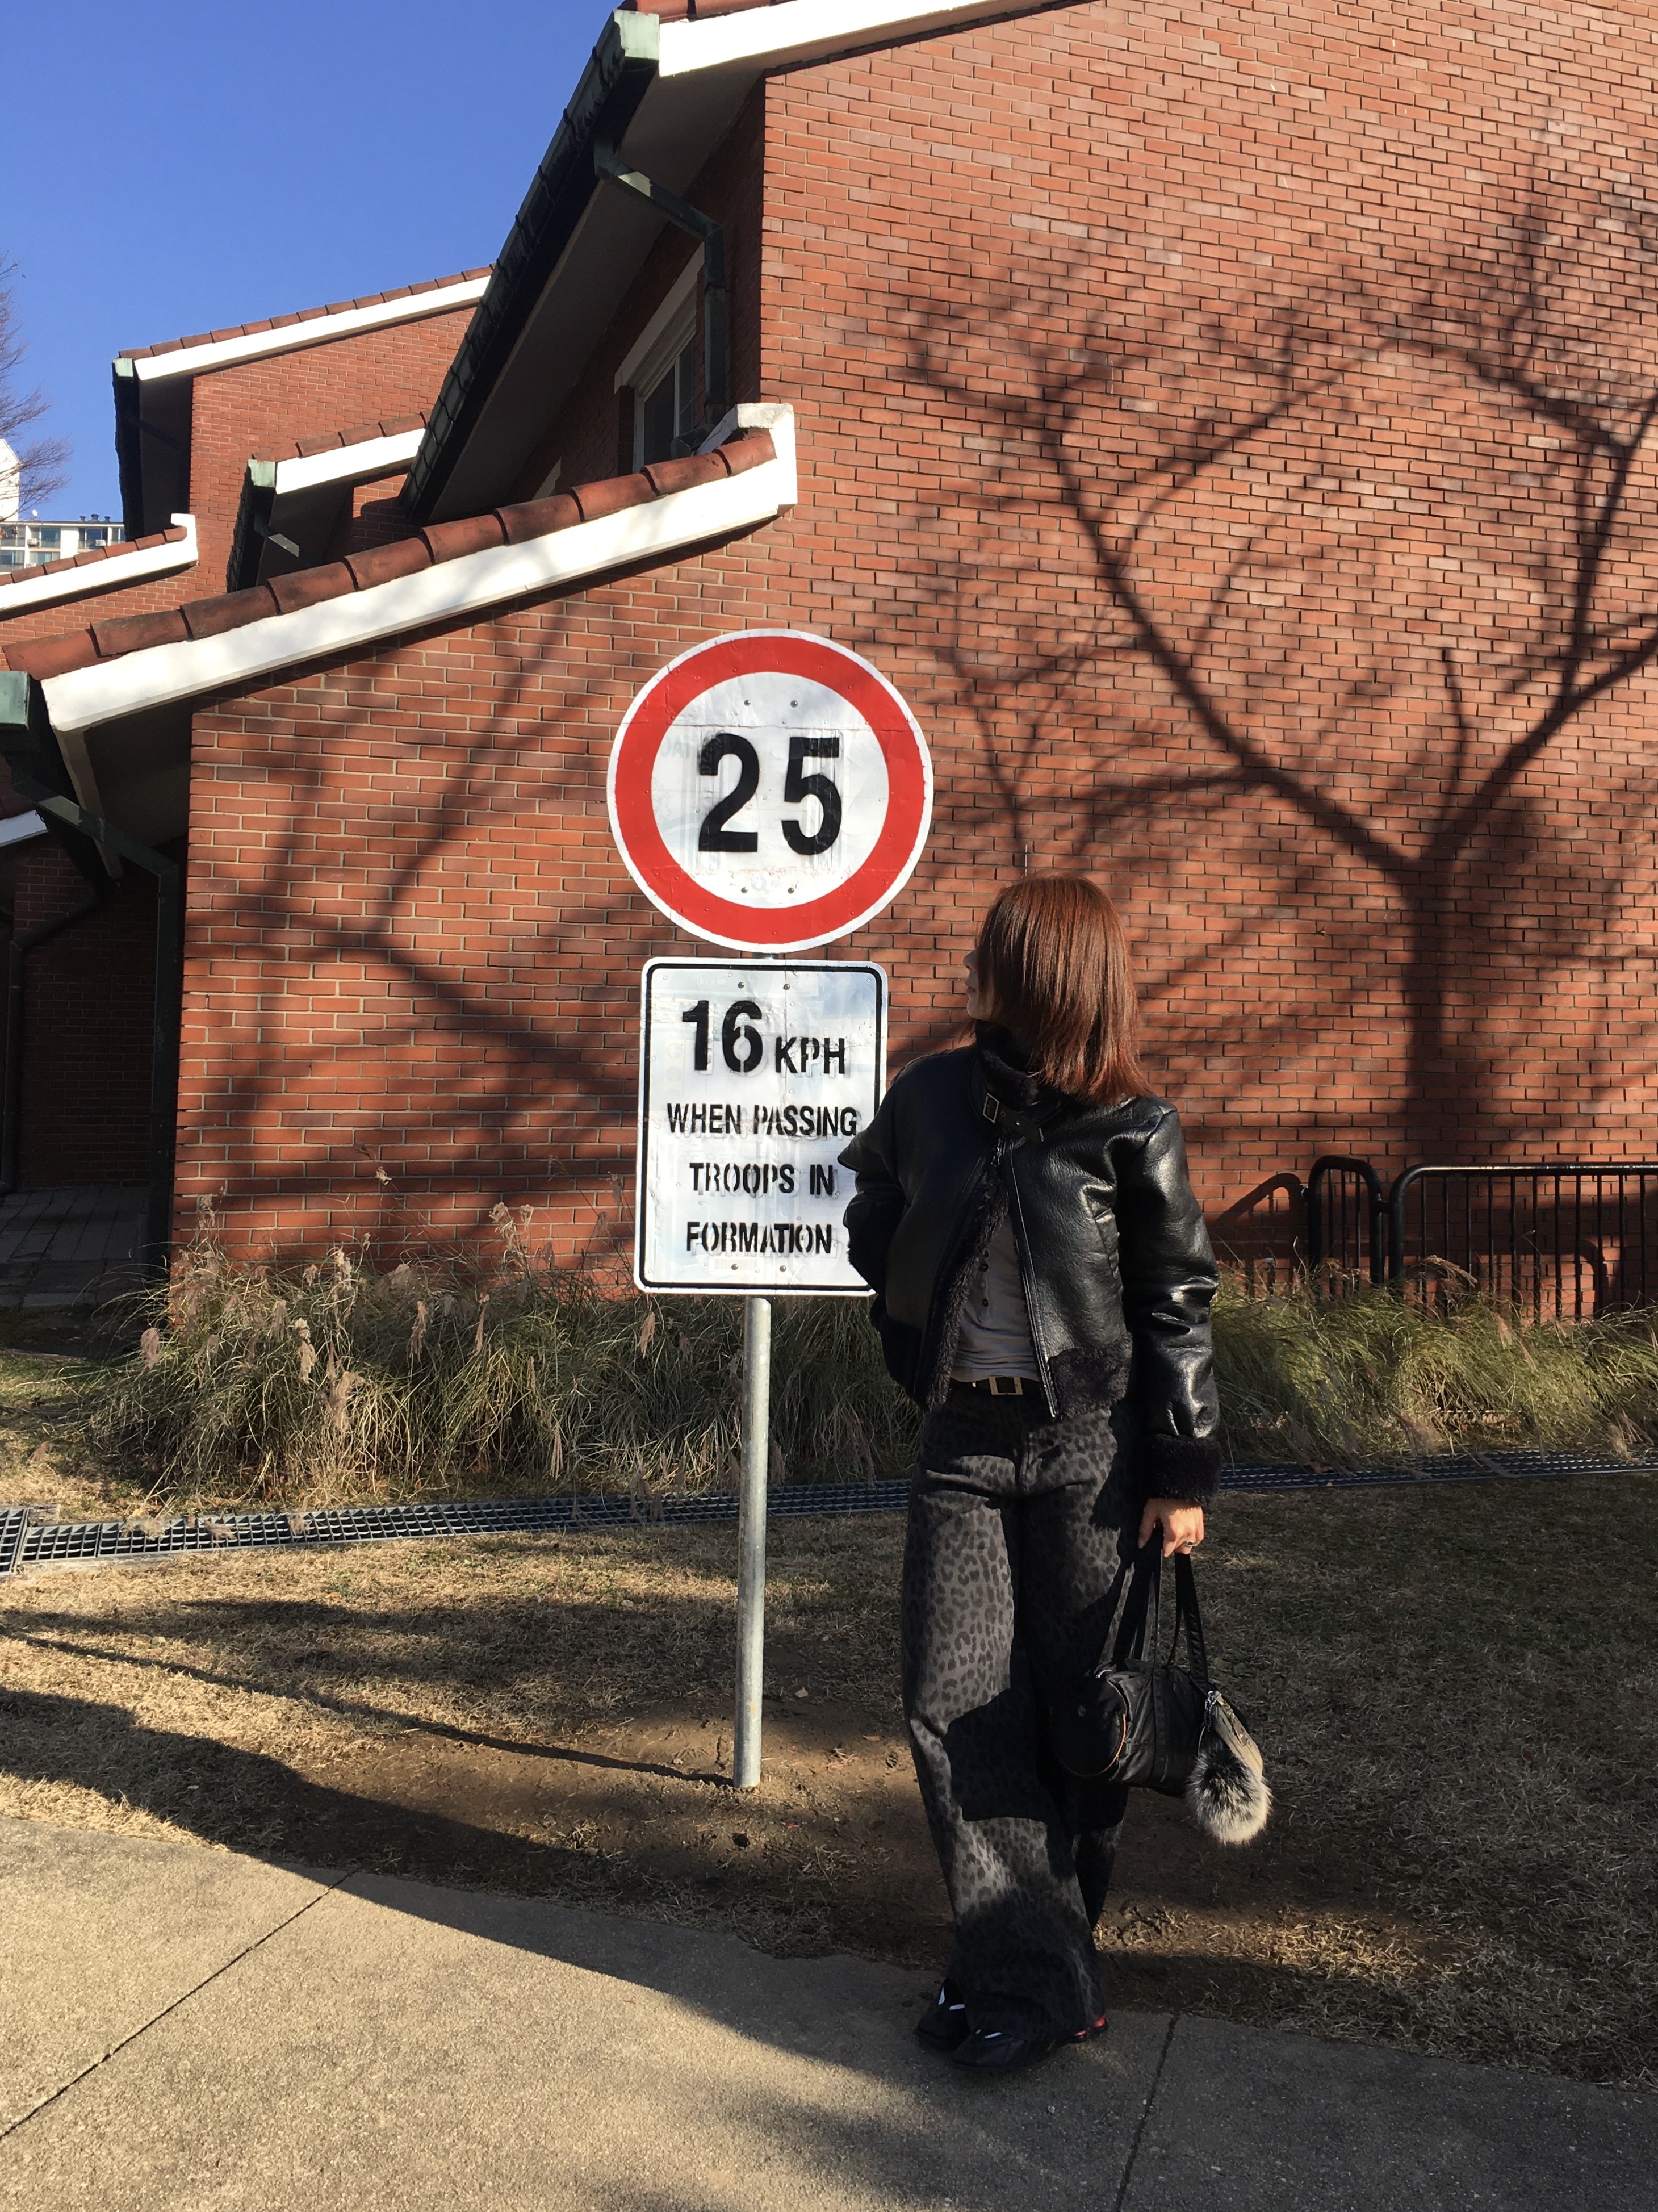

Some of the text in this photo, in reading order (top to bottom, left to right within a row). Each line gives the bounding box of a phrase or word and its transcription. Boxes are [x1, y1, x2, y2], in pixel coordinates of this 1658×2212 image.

[698, 733, 842, 855] 25
[682, 1000, 845, 1074] 16 KPH
[667, 1103, 857, 1136] WHEN PASSING
[689, 1163, 834, 1195] TROOPS IN
[687, 1222, 832, 1253] FORMATION
